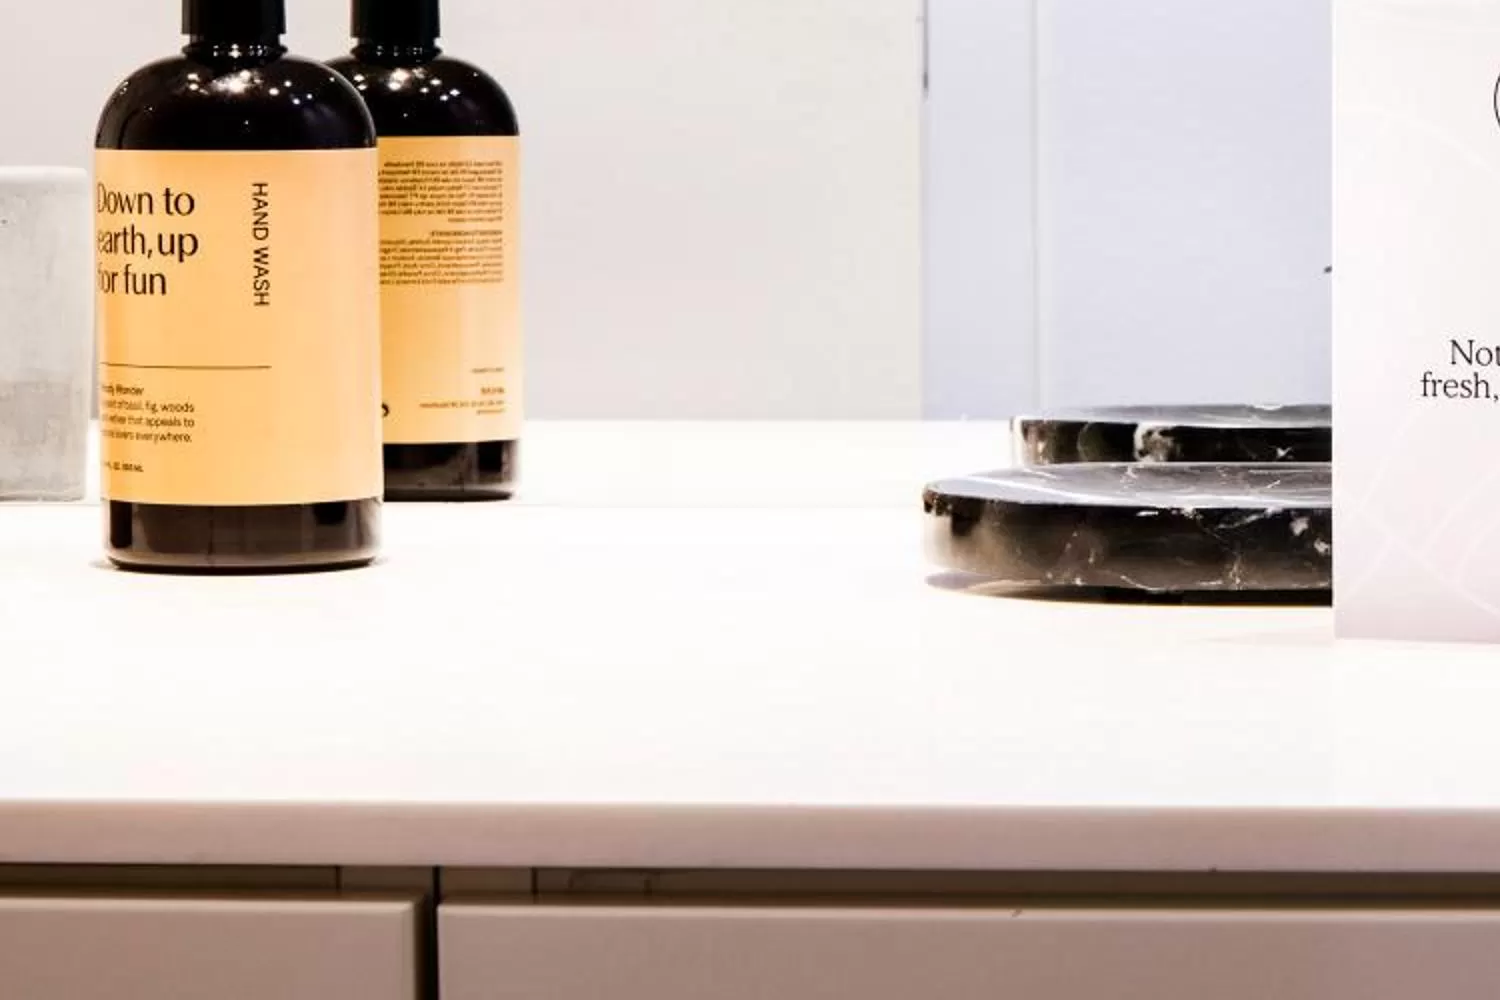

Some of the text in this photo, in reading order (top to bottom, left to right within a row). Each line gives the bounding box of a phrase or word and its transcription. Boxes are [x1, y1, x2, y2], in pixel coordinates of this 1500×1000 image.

[97, 181, 195, 216] Down to
[97, 222, 198, 263] earth, up
[252, 182, 270, 307] HAND WASH
[123, 262, 167, 295] fun
[1420, 371, 1499, 403] fresh,
[146, 416, 182, 429] appeals
[183, 416, 195, 427] to
[160, 402, 195, 413] woods
